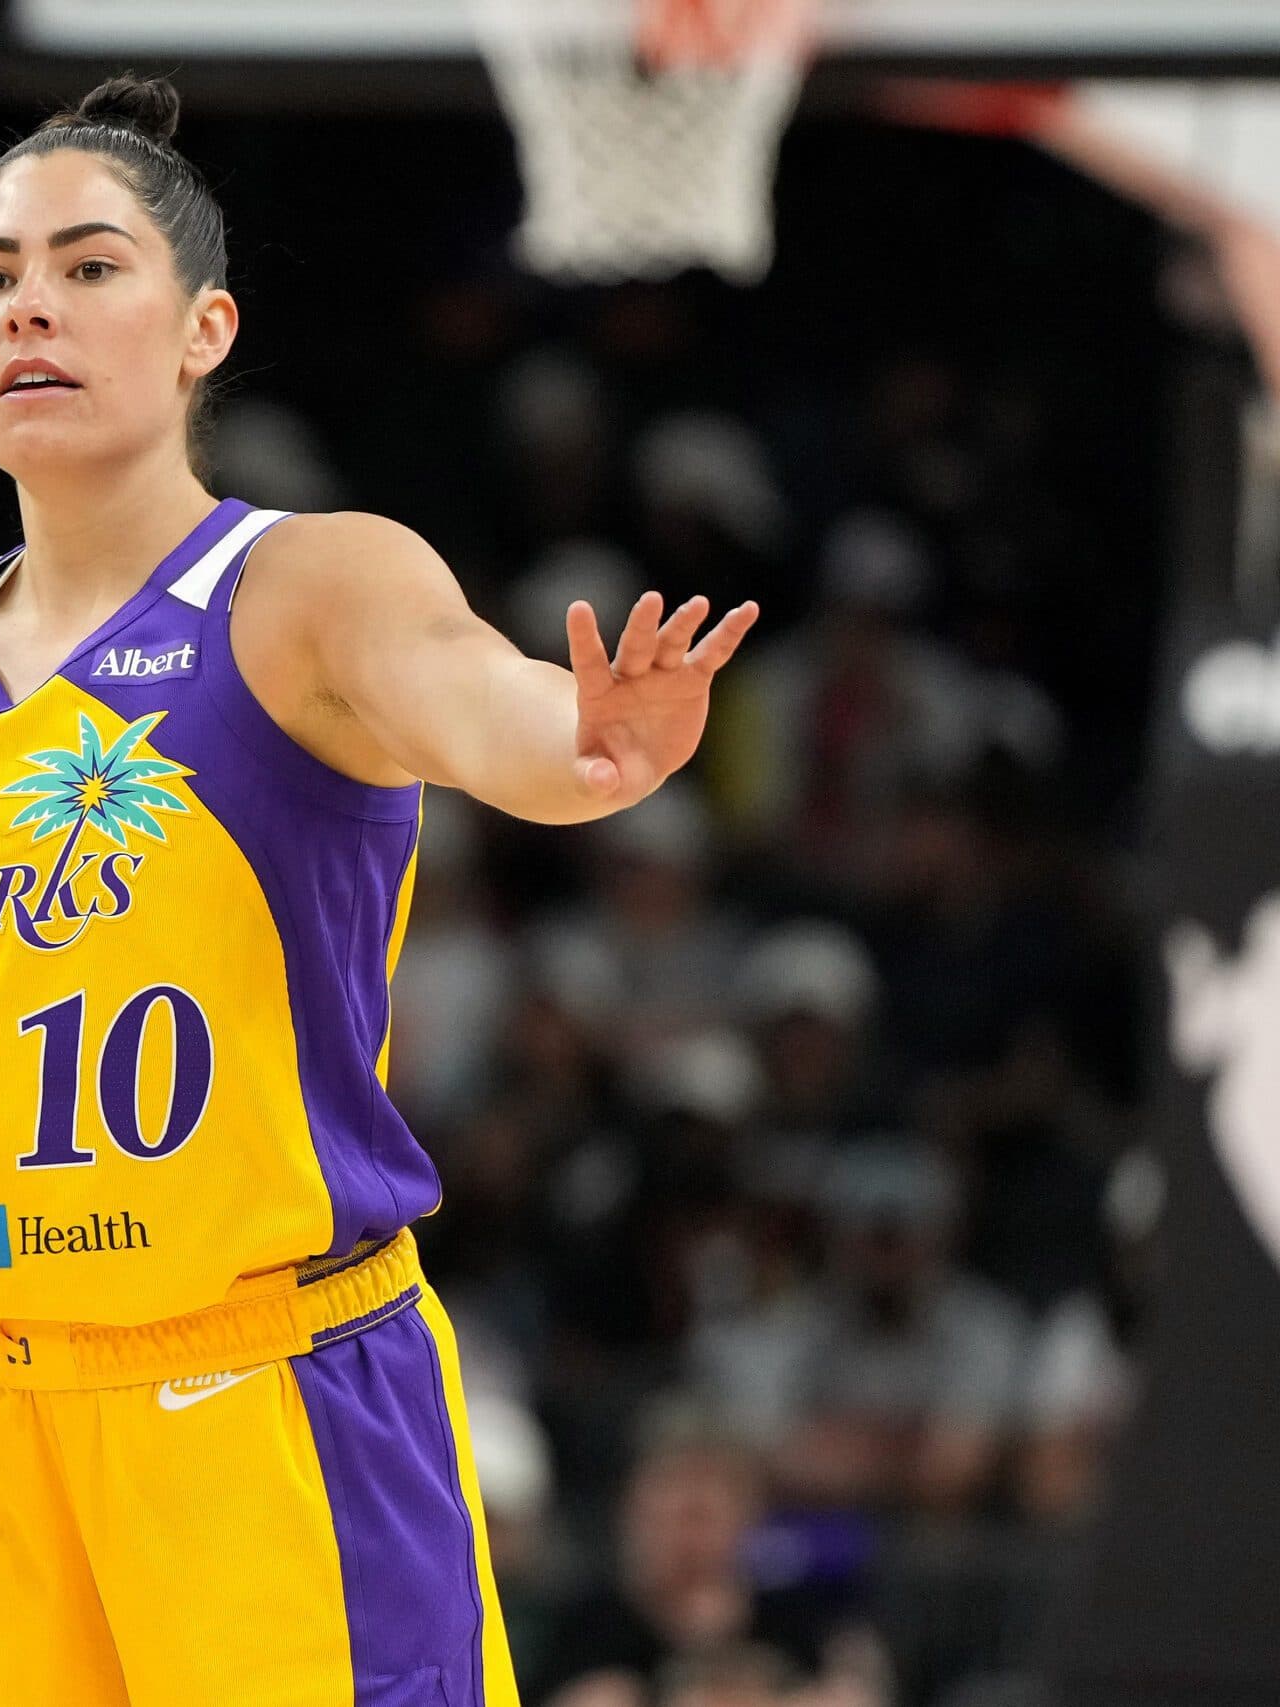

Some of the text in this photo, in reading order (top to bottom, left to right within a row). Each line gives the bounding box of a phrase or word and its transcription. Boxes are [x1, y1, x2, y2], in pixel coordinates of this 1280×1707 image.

[91, 643, 195, 677] Albert
[16, 981, 215, 1171] 10
[19, 1211, 152, 1256] Health
